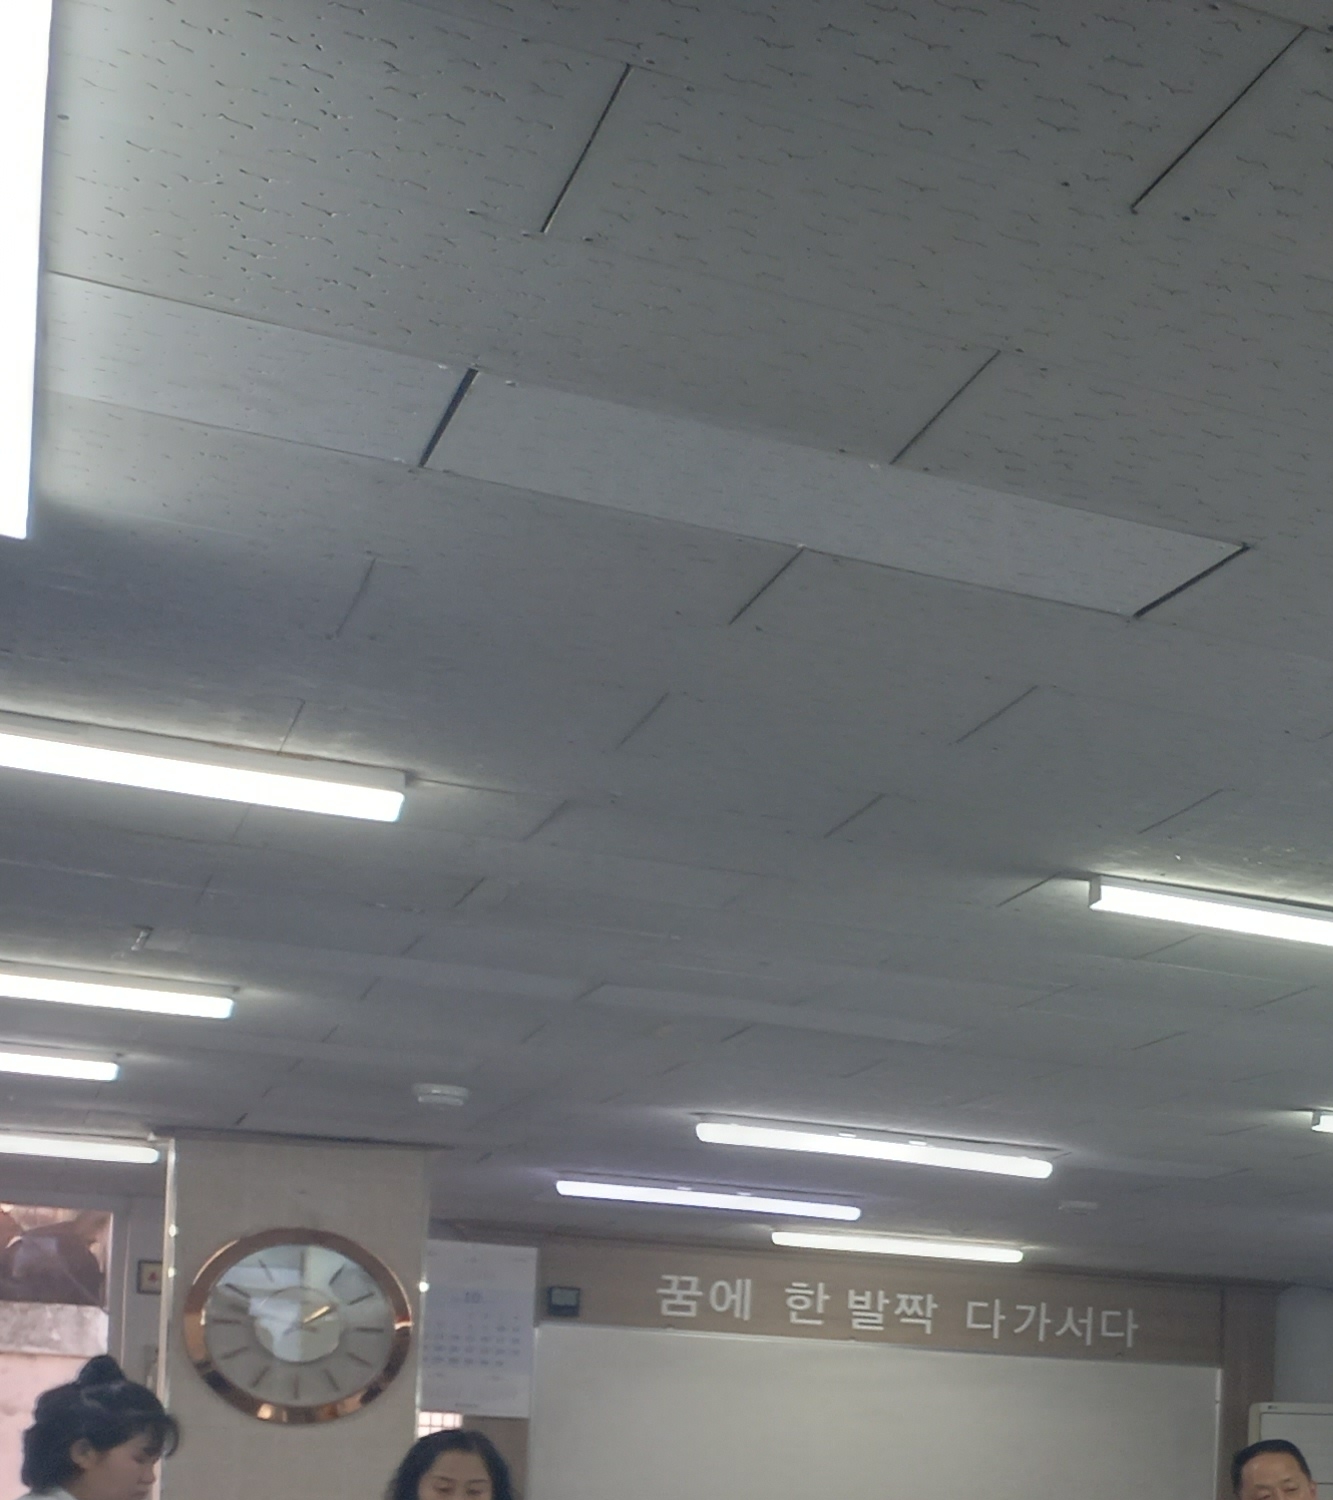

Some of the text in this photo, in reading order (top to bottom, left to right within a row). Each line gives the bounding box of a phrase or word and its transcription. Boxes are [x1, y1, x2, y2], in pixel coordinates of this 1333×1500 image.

[655, 1273, 1139, 1348] 꿈에 한 발짝 다가서다
